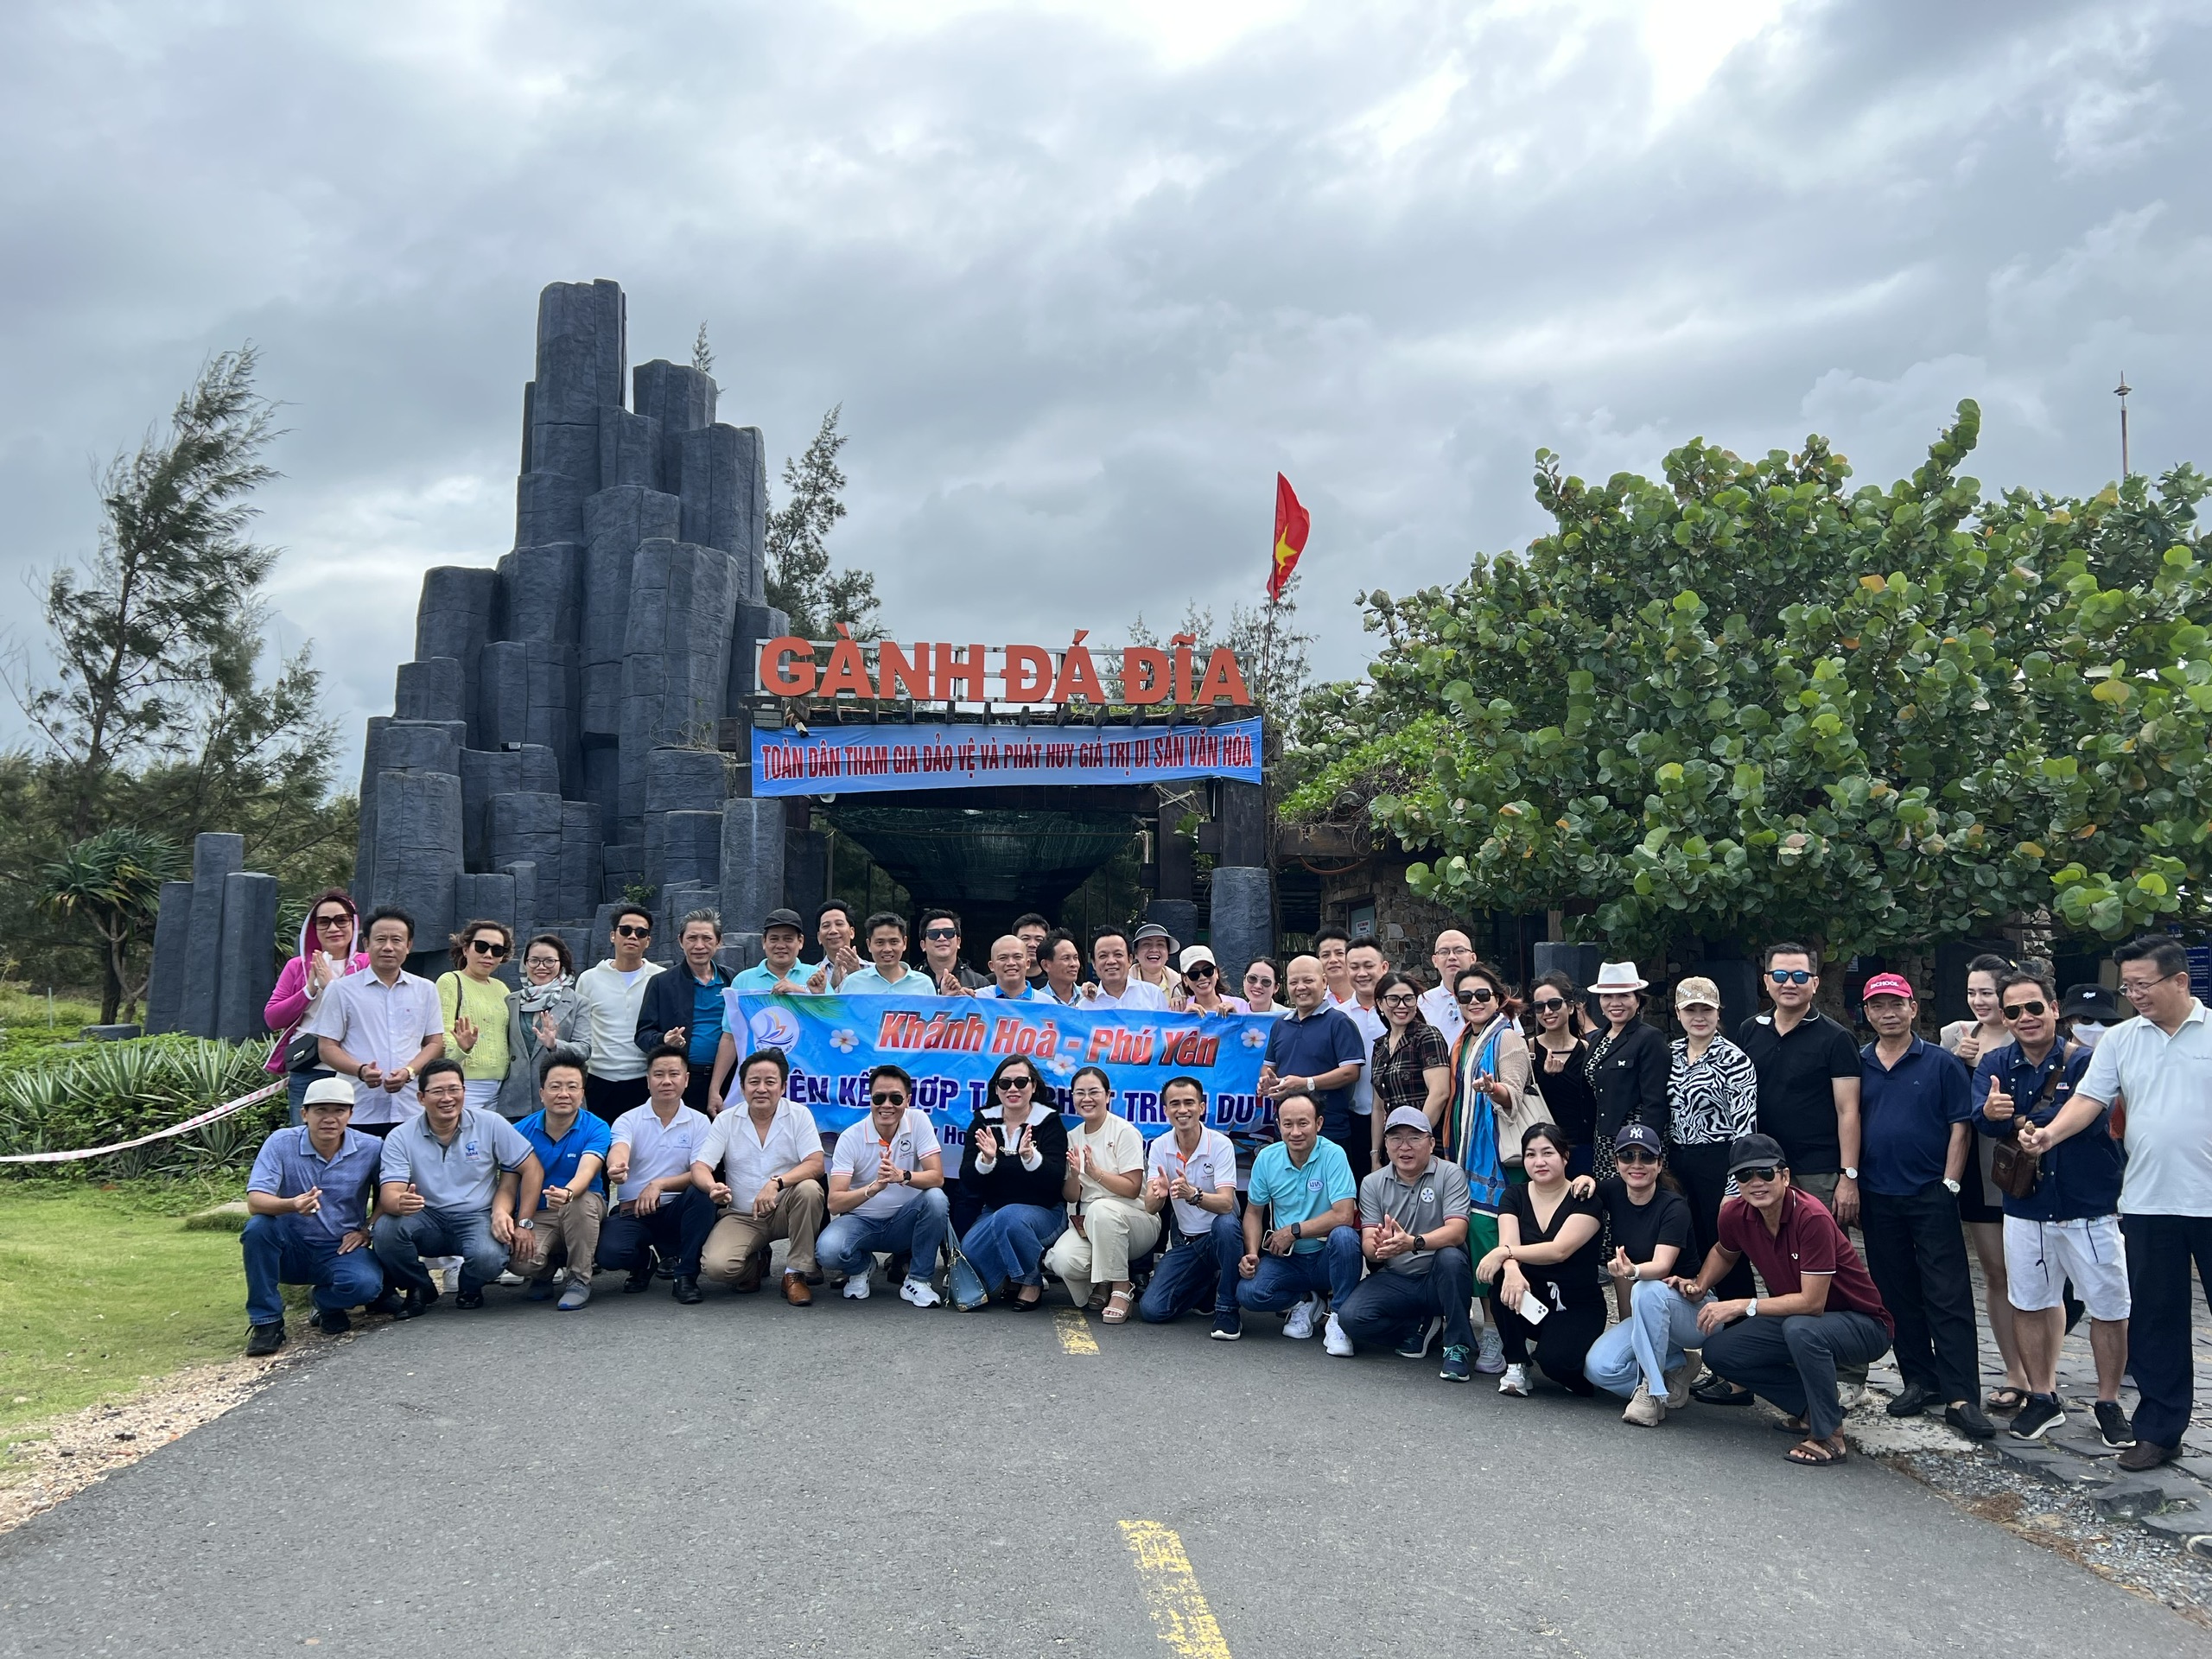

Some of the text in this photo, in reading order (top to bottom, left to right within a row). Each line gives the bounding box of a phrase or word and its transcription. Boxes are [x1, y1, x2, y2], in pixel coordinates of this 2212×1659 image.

[760, 621, 1250, 706] GÀNH ĐÁ ĐĨA
[761, 739, 804, 781] TOÀN
[808, 740, 840, 778] DÂN
[844, 745, 888, 776] THAM
[893, 744, 918, 774] GIA
[957, 736, 976, 779] VỆ
[980, 735, 1000, 771] VÀ
[1004, 736, 1041, 769] PHÁT
[1046, 743, 1075, 768] HUY
[1080, 735, 1103, 768] GIÁ
[1108, 741, 1130, 776] TRỊ
[1135, 739, 1150, 767] DI
[1154, 729, 1185, 767] SẢN
[1189, 728, 1218, 767] VĂN
[1222, 727, 1252, 767] HÓA
[875, 1010, 986, 1052] Khánh
[990, 1017, 1058, 1058] Hoà
[1084, 1025, 1155, 1065] Phú
[1158, 1027, 1220, 1067] Yên
[782, 1069, 830, 1103] ÊN
[1217, 1095, 1255, 1124] DU
